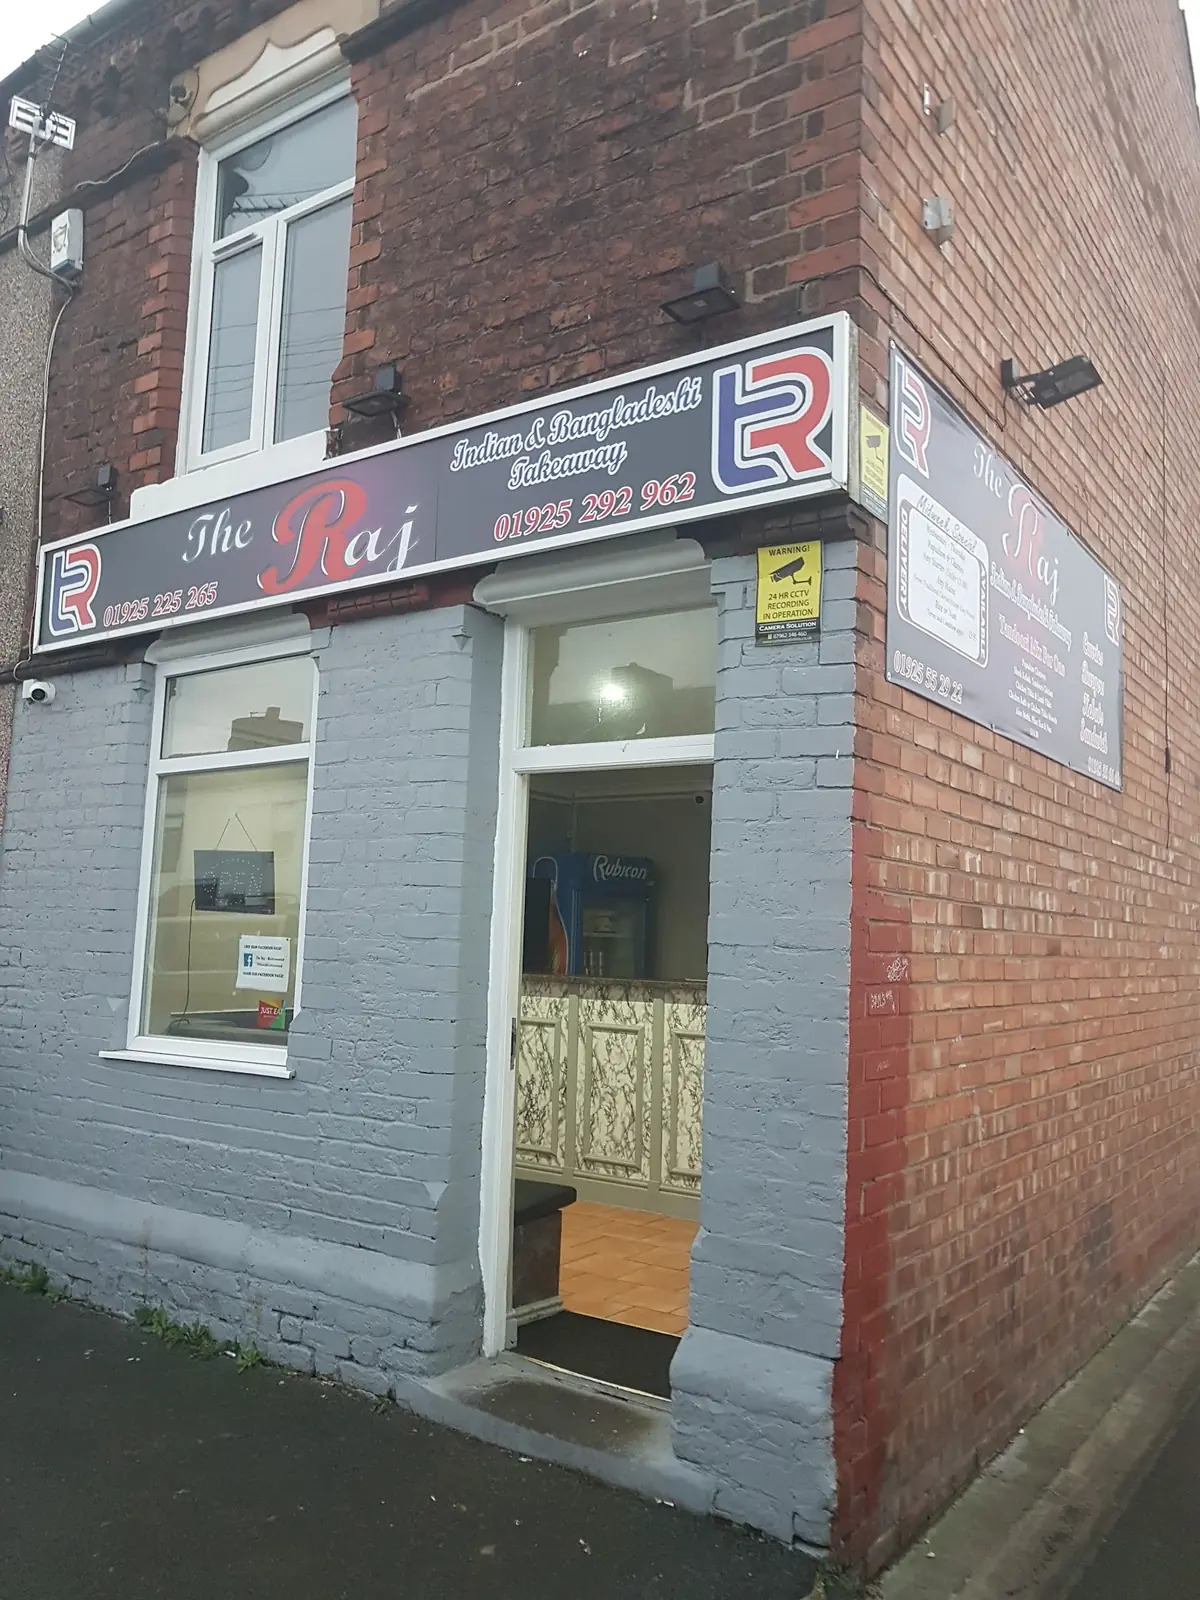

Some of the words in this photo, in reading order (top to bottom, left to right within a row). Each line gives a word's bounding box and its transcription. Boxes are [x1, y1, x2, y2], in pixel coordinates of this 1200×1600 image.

[451, 433, 522, 473] Indian
[525, 419, 546, 453] &
[547, 376, 703, 443] Bangladeshi
[508, 440, 627, 491] Takeaway
[973, 443, 1002, 498] The
[494, 499, 571, 542] 01925
[580, 487, 632, 524] 292
[641, 472, 696, 512] 962
[182, 508, 253, 563] The
[257, 478, 418, 595] Raj
[768, 545, 810, 557] WARNING!
[900, 506, 908, 611] DELIVERY
[1002, 483, 1060, 605] Raj
[102, 597, 148, 628] 01925
[152, 589, 182, 616] 225
[185, 580, 218, 608] 265
[768, 599, 809, 610] RECORDING
[772, 608, 813, 619] OPERATION
[778, 591, 789, 600] HR
[790, 590, 809, 599] CCTV
[759, 624, 785, 632] CAMERA
[894, 650, 924, 684] 01925
[925, 666, 938, 691] 55
[938, 674, 951, 698] 29
[951, 681, 963, 704] 22
[203, 871, 262, 895] OPEN
[592, 854, 647, 882] Rubicon
[260, 1007, 272, 1015] JUST
